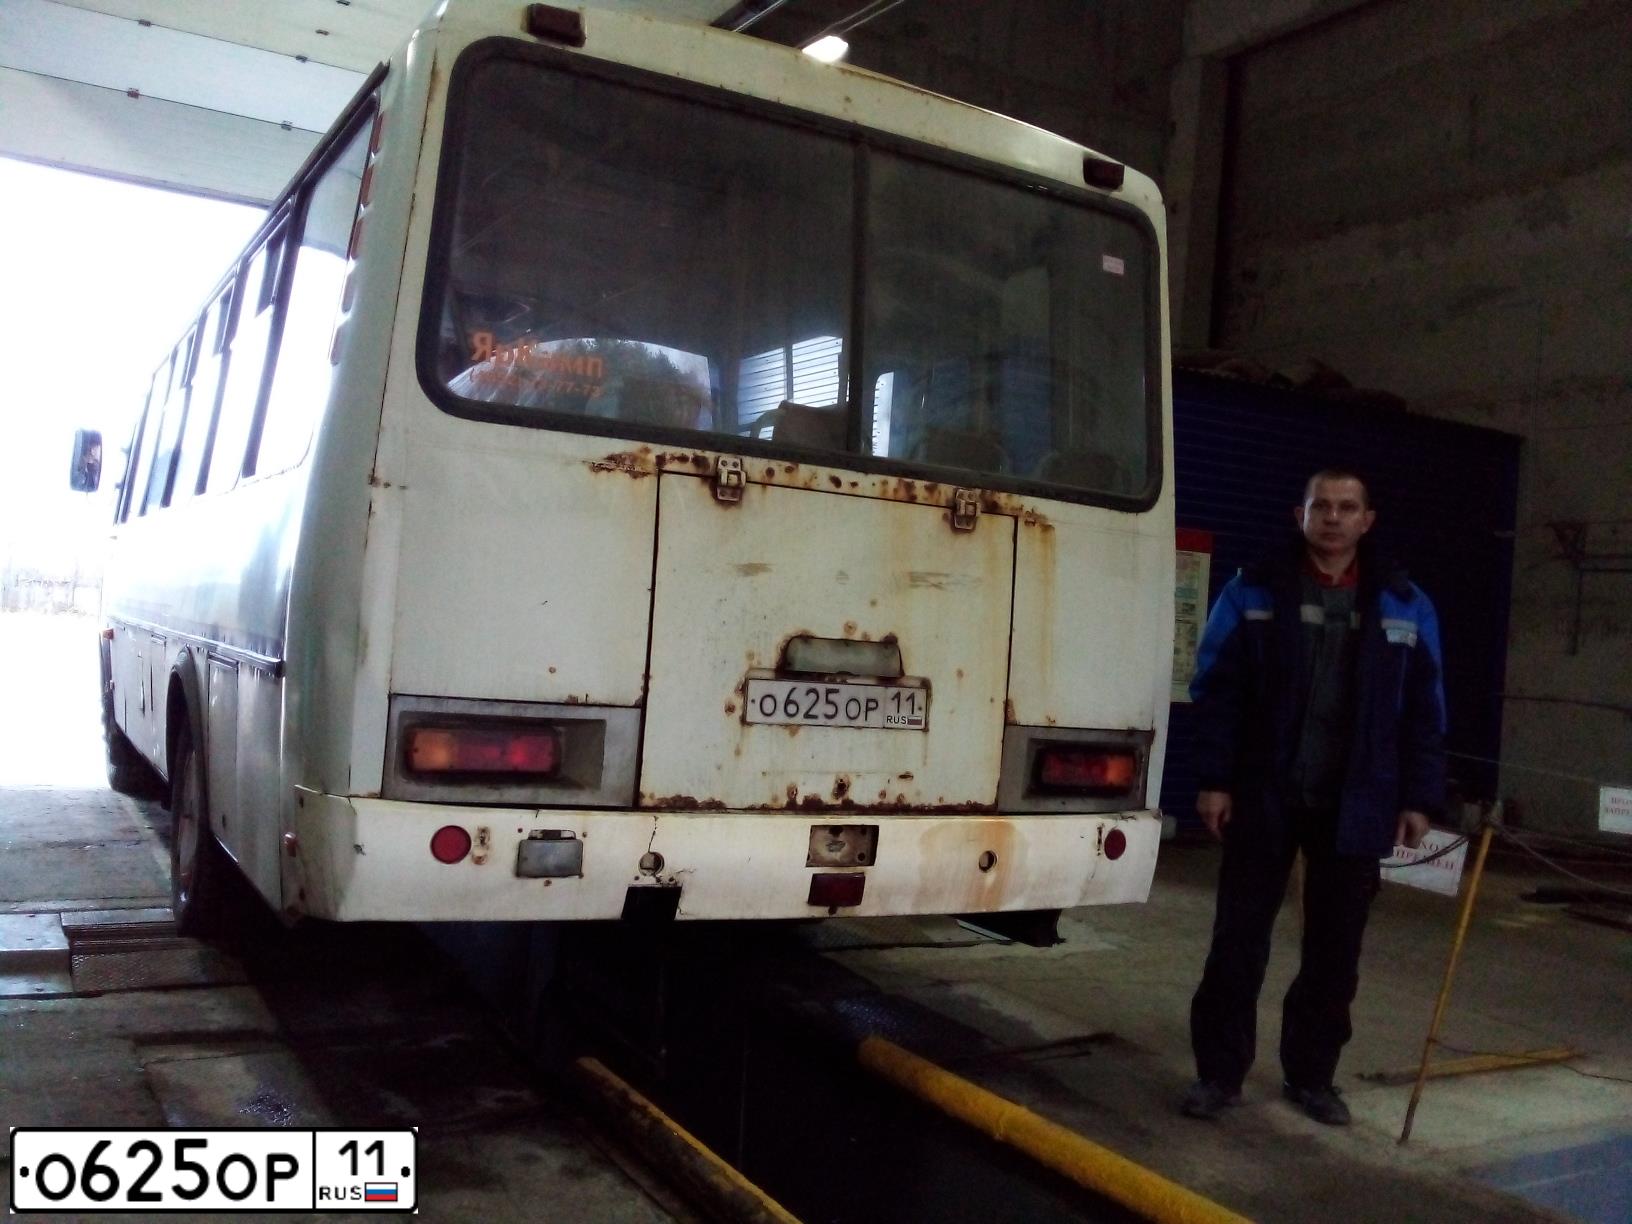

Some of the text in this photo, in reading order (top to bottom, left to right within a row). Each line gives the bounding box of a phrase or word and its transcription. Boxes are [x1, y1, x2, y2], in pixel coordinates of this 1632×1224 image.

[759, 687, 916, 721] О625ОР 11
[886, 715, 907, 725] RUS
